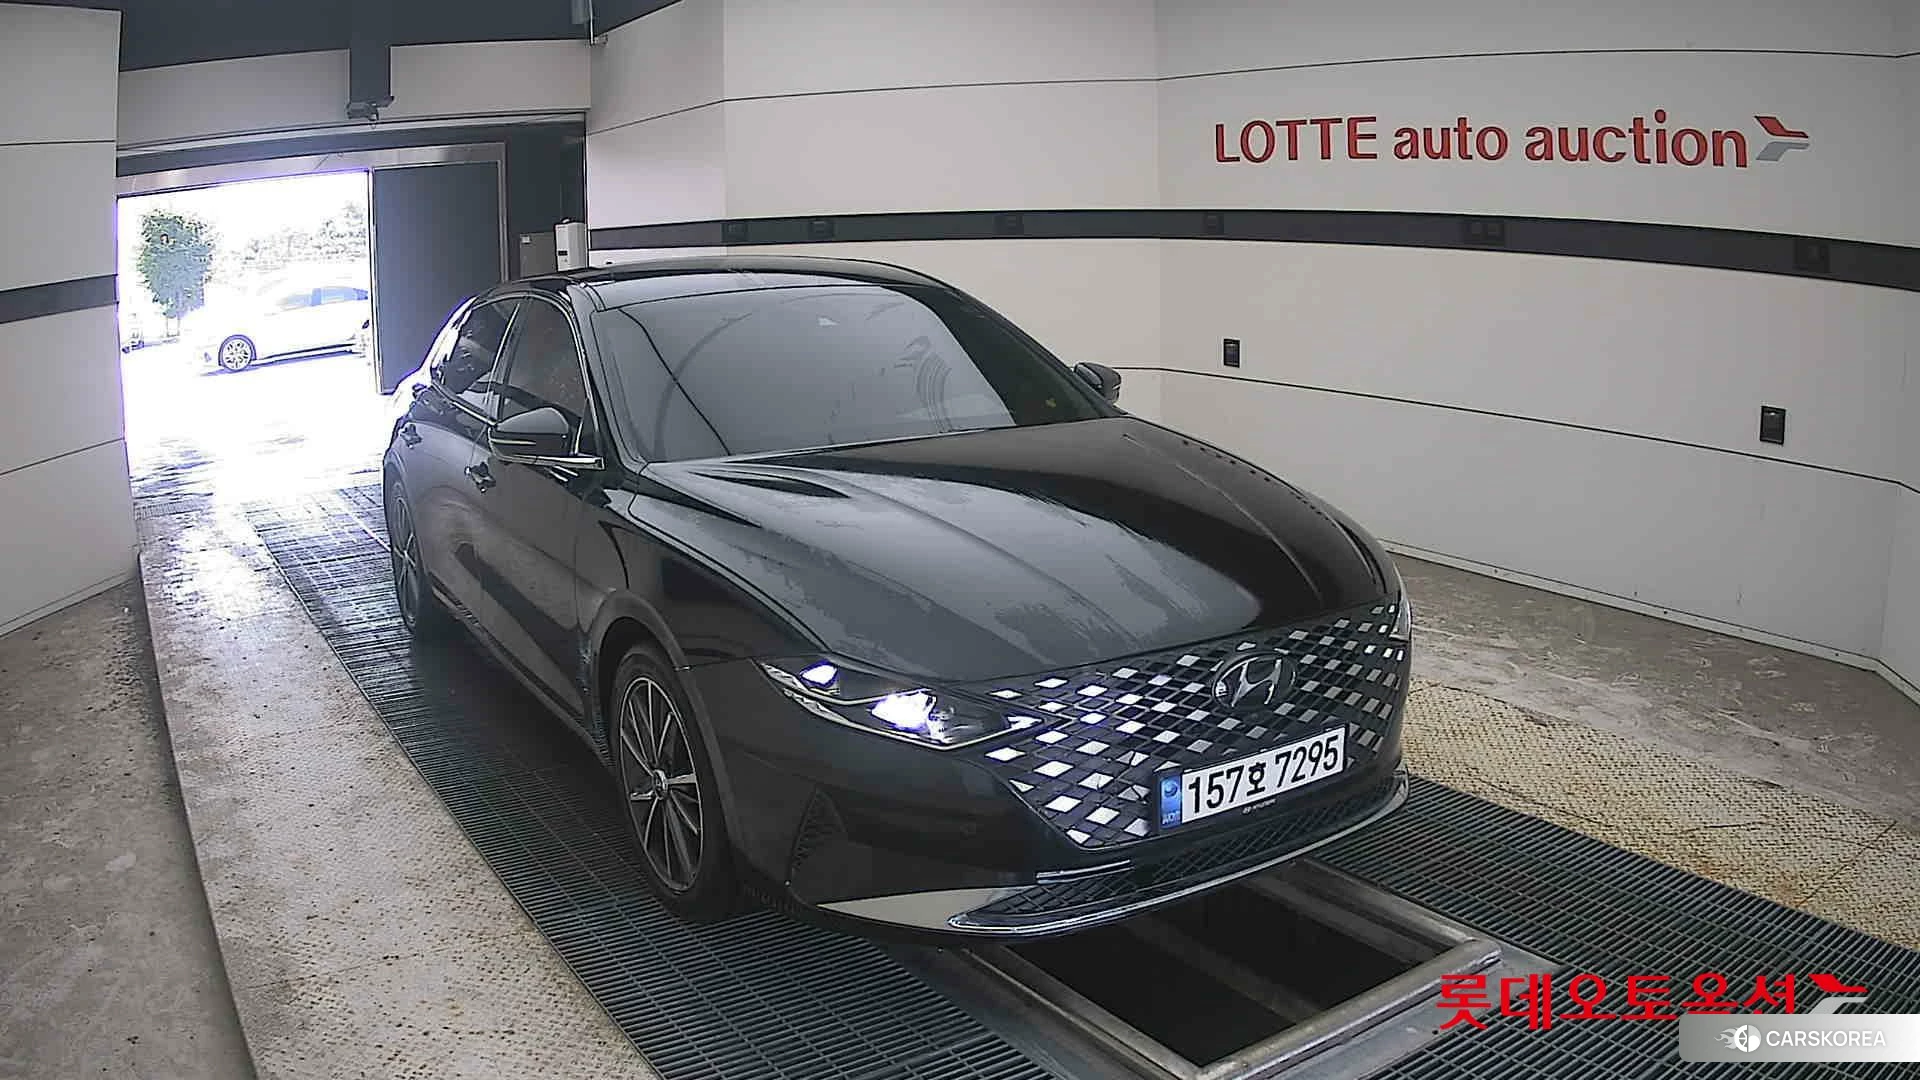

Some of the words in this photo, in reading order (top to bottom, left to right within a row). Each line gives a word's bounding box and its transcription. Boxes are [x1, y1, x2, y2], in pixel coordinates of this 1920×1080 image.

[1214, 116, 1378, 163] LOTTE
[1393, 116, 1509, 162] auto
[1524, 108, 1749, 169] auction
[1188, 761, 1267, 814] 157호
[1274, 734, 1339, 789] 7295
